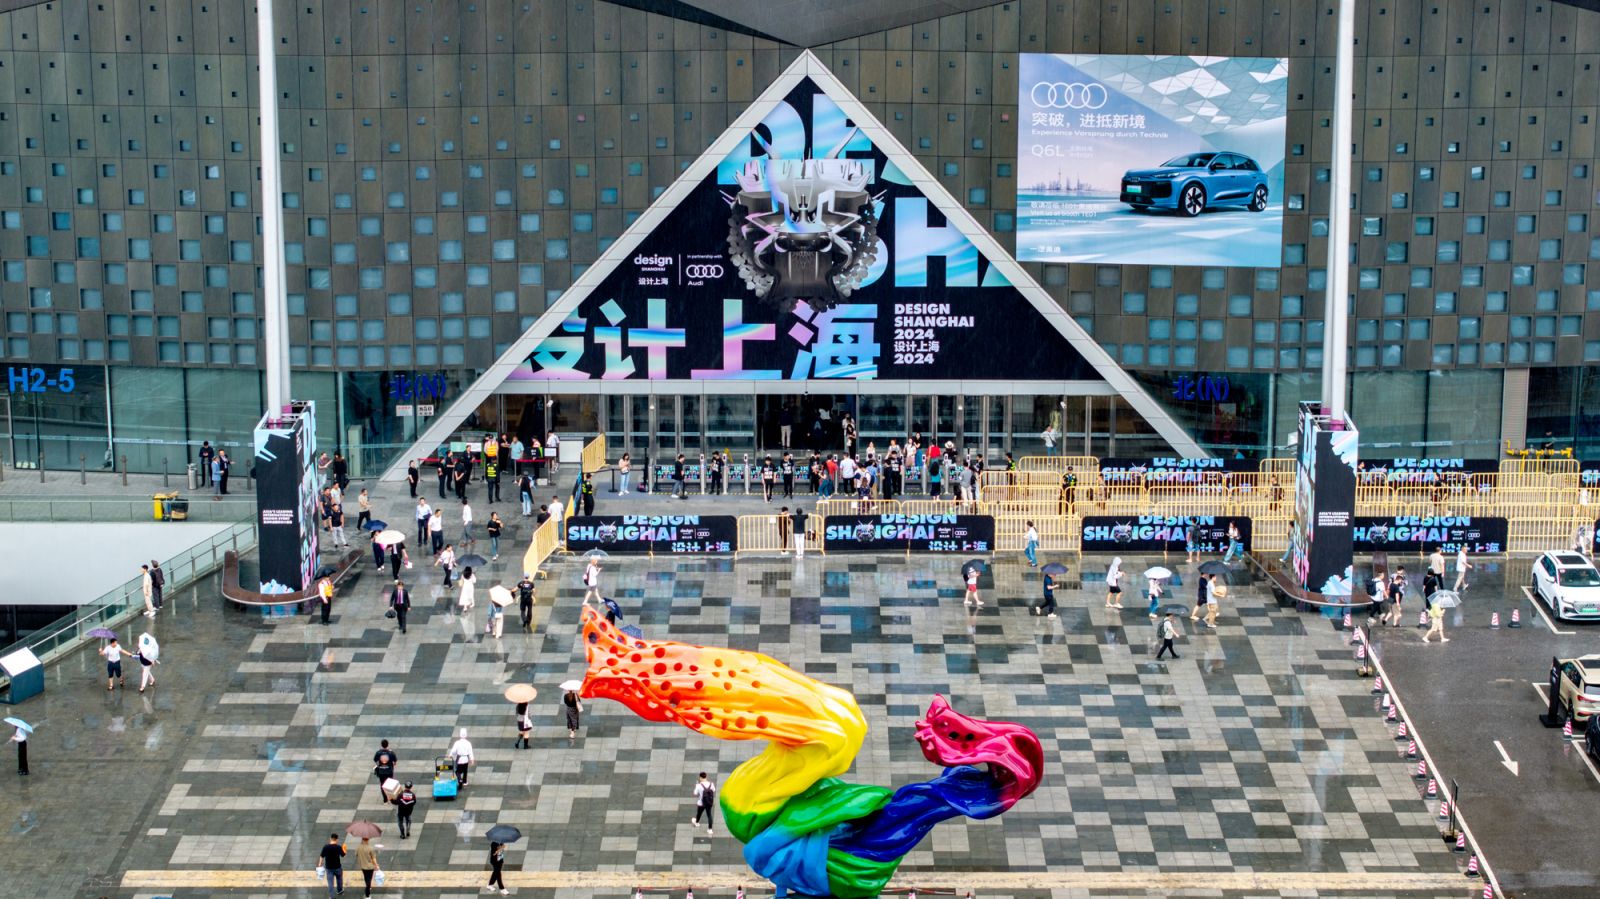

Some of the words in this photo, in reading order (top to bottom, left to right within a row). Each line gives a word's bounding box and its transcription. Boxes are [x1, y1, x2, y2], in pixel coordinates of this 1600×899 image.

[1031, 129, 1073, 137] Experience
[1074, 130, 1115, 138] Vorsprung
[1031, 144, 1065, 158] Q6L
[633, 253, 673, 266] design
[638, 277, 669, 286] 设计上海
[894, 303, 951, 315] DESIGN
[894, 315, 975, 328] SHANGHAI
[894, 328, 935, 340] 2024
[894, 340, 941, 353] 设计上海
[893, 353, 935, 365] 2024
[8, 366, 76, 393] H2-5
[623, 515, 700, 526] DESIGN
[881, 514, 957, 524] DESIGN
[1395, 516, 1471, 527] DESIGN
